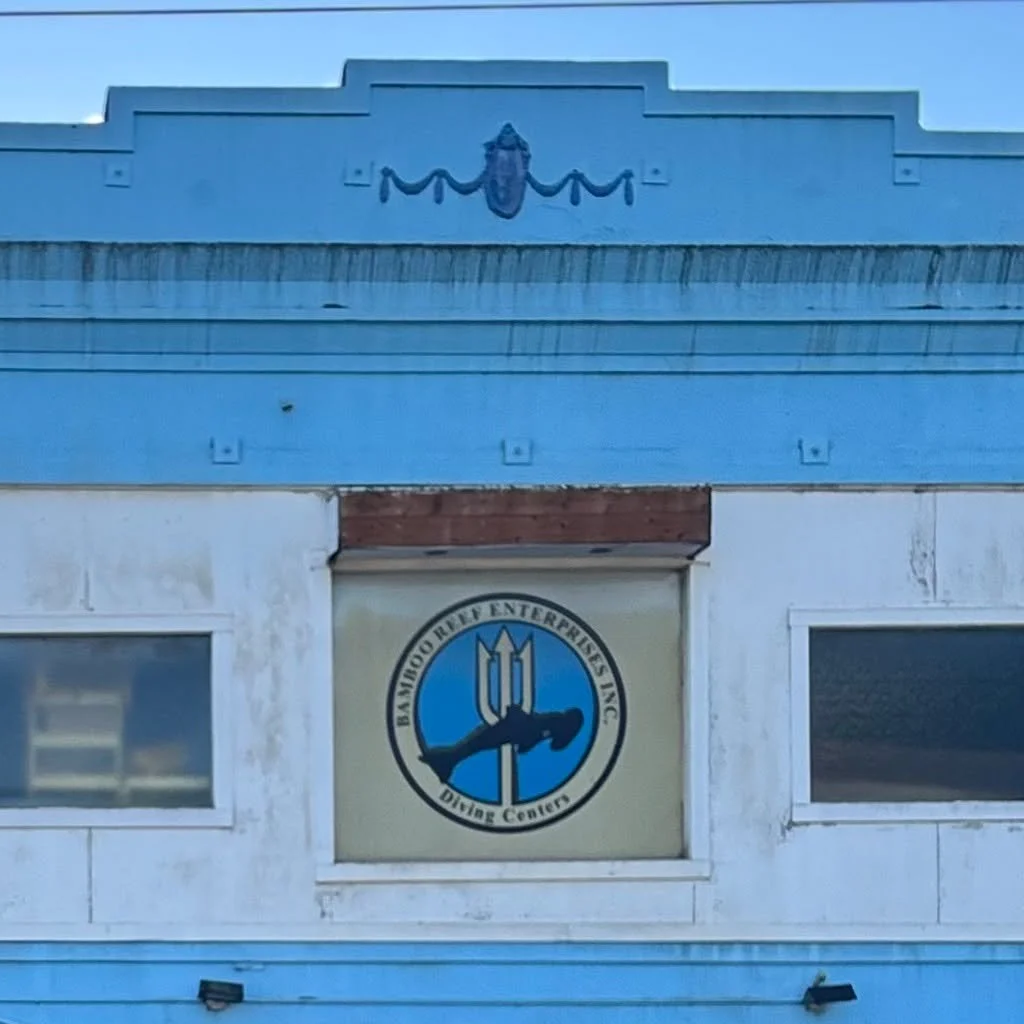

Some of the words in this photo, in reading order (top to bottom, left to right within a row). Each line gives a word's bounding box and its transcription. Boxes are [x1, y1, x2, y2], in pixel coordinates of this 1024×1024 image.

[396, 640, 434, 727] BAMBOO
[434, 605, 483, 642] REEF
[490, 602, 610, 685] ENTERPRISES
[439, 788, 496, 824] Diving
[502, 793, 571, 823] Centers
